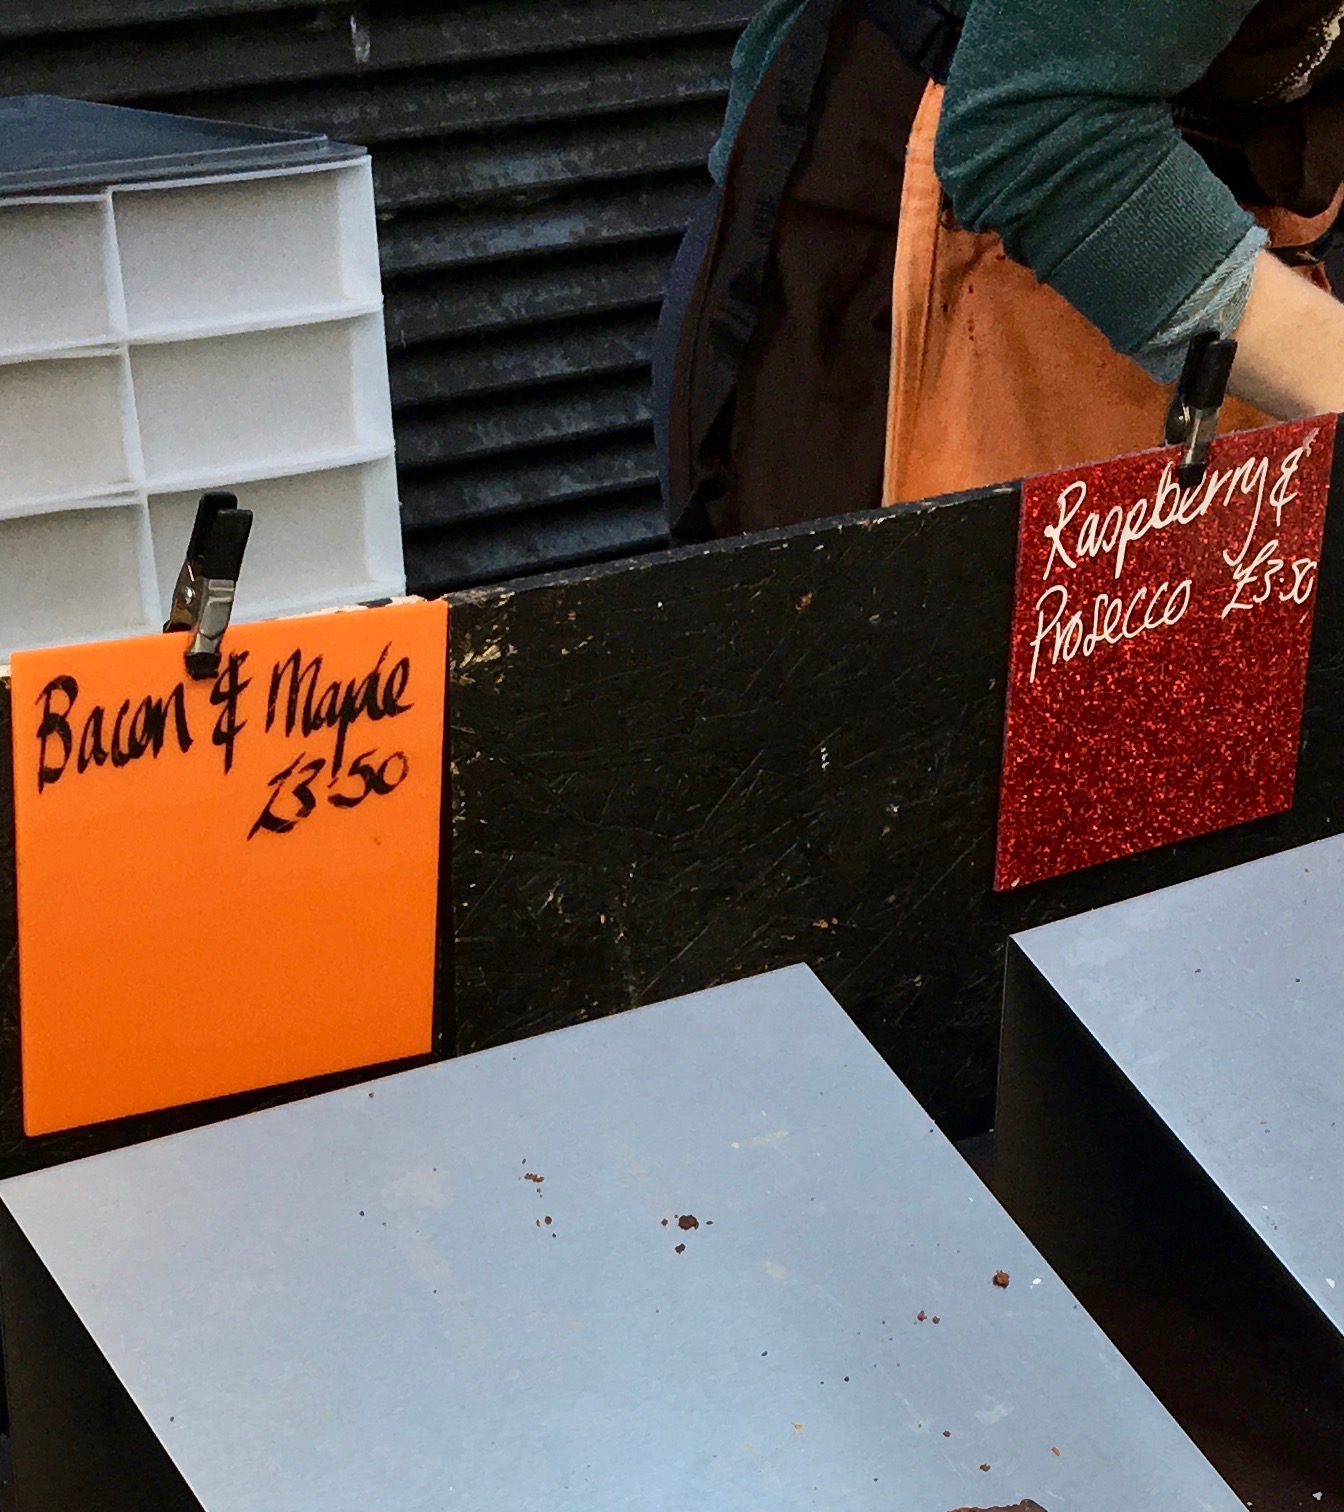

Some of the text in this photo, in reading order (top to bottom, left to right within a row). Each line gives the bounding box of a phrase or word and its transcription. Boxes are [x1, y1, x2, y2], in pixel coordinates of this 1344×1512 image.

[1043, 428, 1320, 580] Raspberry &
[1030, 580, 1192, 684] Prosecco
[35, 642, 415, 794] Bacon & Maple
